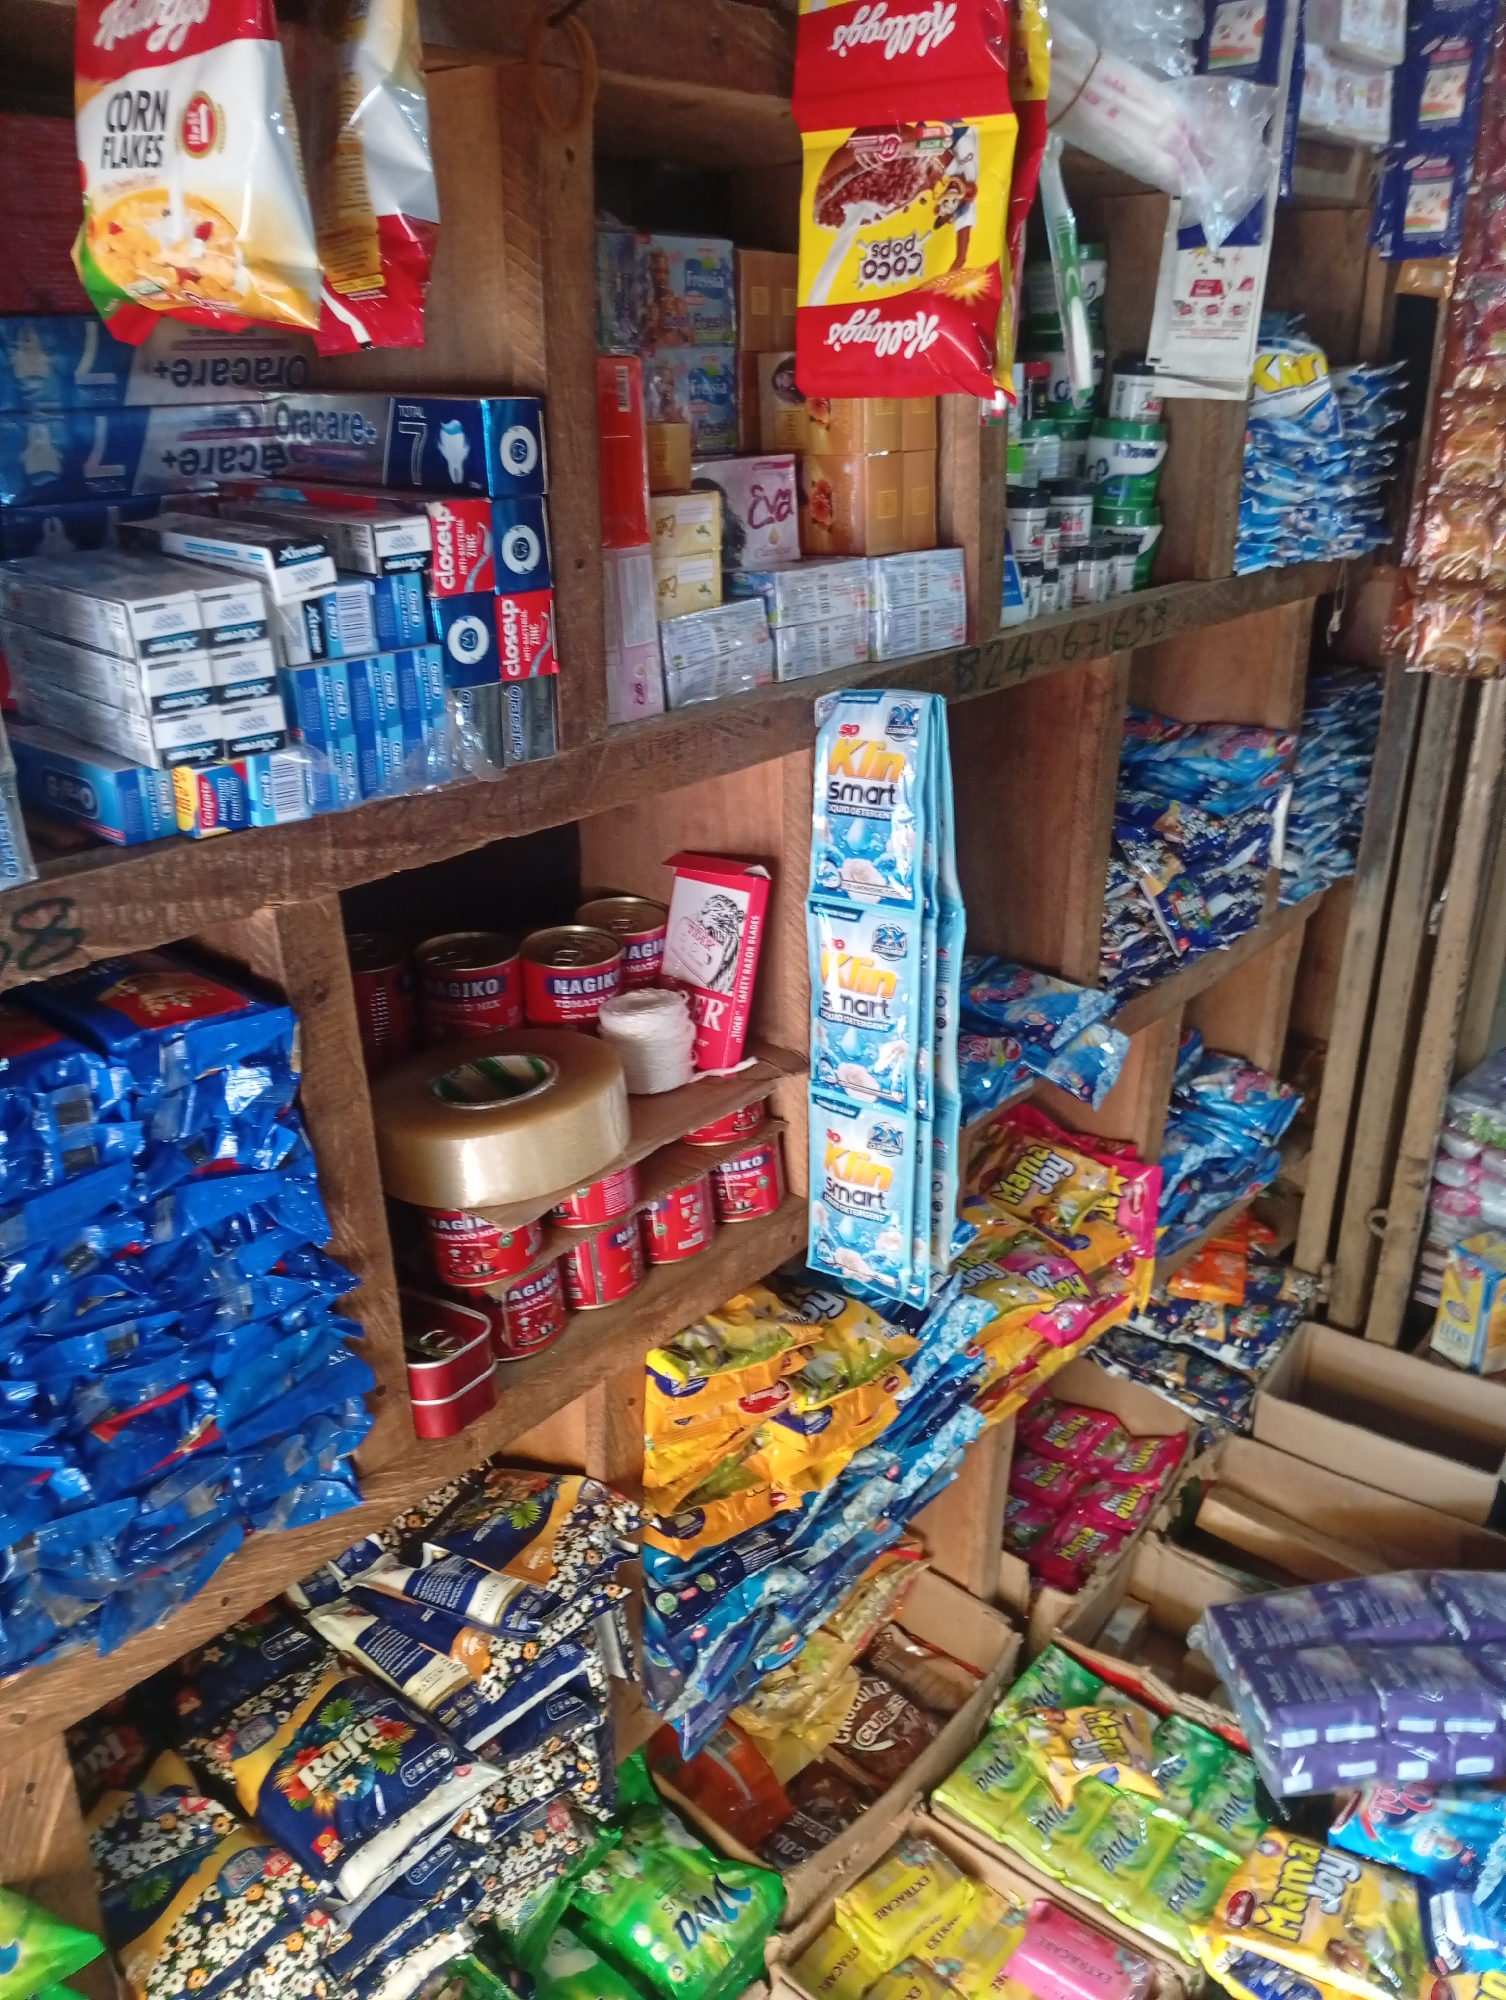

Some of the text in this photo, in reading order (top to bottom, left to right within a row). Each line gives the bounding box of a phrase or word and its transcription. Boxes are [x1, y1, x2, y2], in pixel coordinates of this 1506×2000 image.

[106, 89, 169, 133] CORN
[101, 134, 165, 169] FLAKES
[871, 234, 917, 260] pops
[827, 308, 939, 359] Kellogg's
[397, 404, 428, 419] TOTAL
[161, 443, 290, 478] acare+
[398, 421, 428, 486] 7
[430, 500, 457, 590] closeup
[466, 533, 478, 559] ZINC
[500, 598, 521, 678] closeup
[529, 622, 541, 647] ZINC
[891, 706, 920, 726] 2X
[828, 738, 907, 783] Klin
[200, 781, 216, 827] Colgate
[828, 780, 897, 805] smart
[687, 924, 716, 951] TIGER
[748, 914, 761, 944] BLADES
[874, 924, 907, 947] 2X
[741, 944, 756, 975] RAZOR
[820, 949, 898, 999] Klin
[737, 974, 749, 1005] SAFETY
[872, 1125, 905, 1145] 2X
[718, 1154, 764, 1174] GIKO
[823, 1138, 894, 1193] Klin
[991, 1143, 1053, 1205] Mama
[1030, 1151, 1076, 1195] Joy
[824, 1177, 887, 1210] smart
[297, 1720, 380, 1792] Raja
[976, 1748, 1017, 1793] Viva
[1216, 1790, 1252, 1832] Viva
[1100, 1828, 1140, 1875] Viva
[874, 1874, 931, 1921] EXTRACARE
[1166, 1869, 1207, 1915] Viva
[1253, 1840, 1321, 1942] Mama
[1312, 1849, 1363, 1917] Joy
[817, 1945, 860, 1995] XTRACARE
[1036, 1935, 1114, 1987] EXTRACARE
